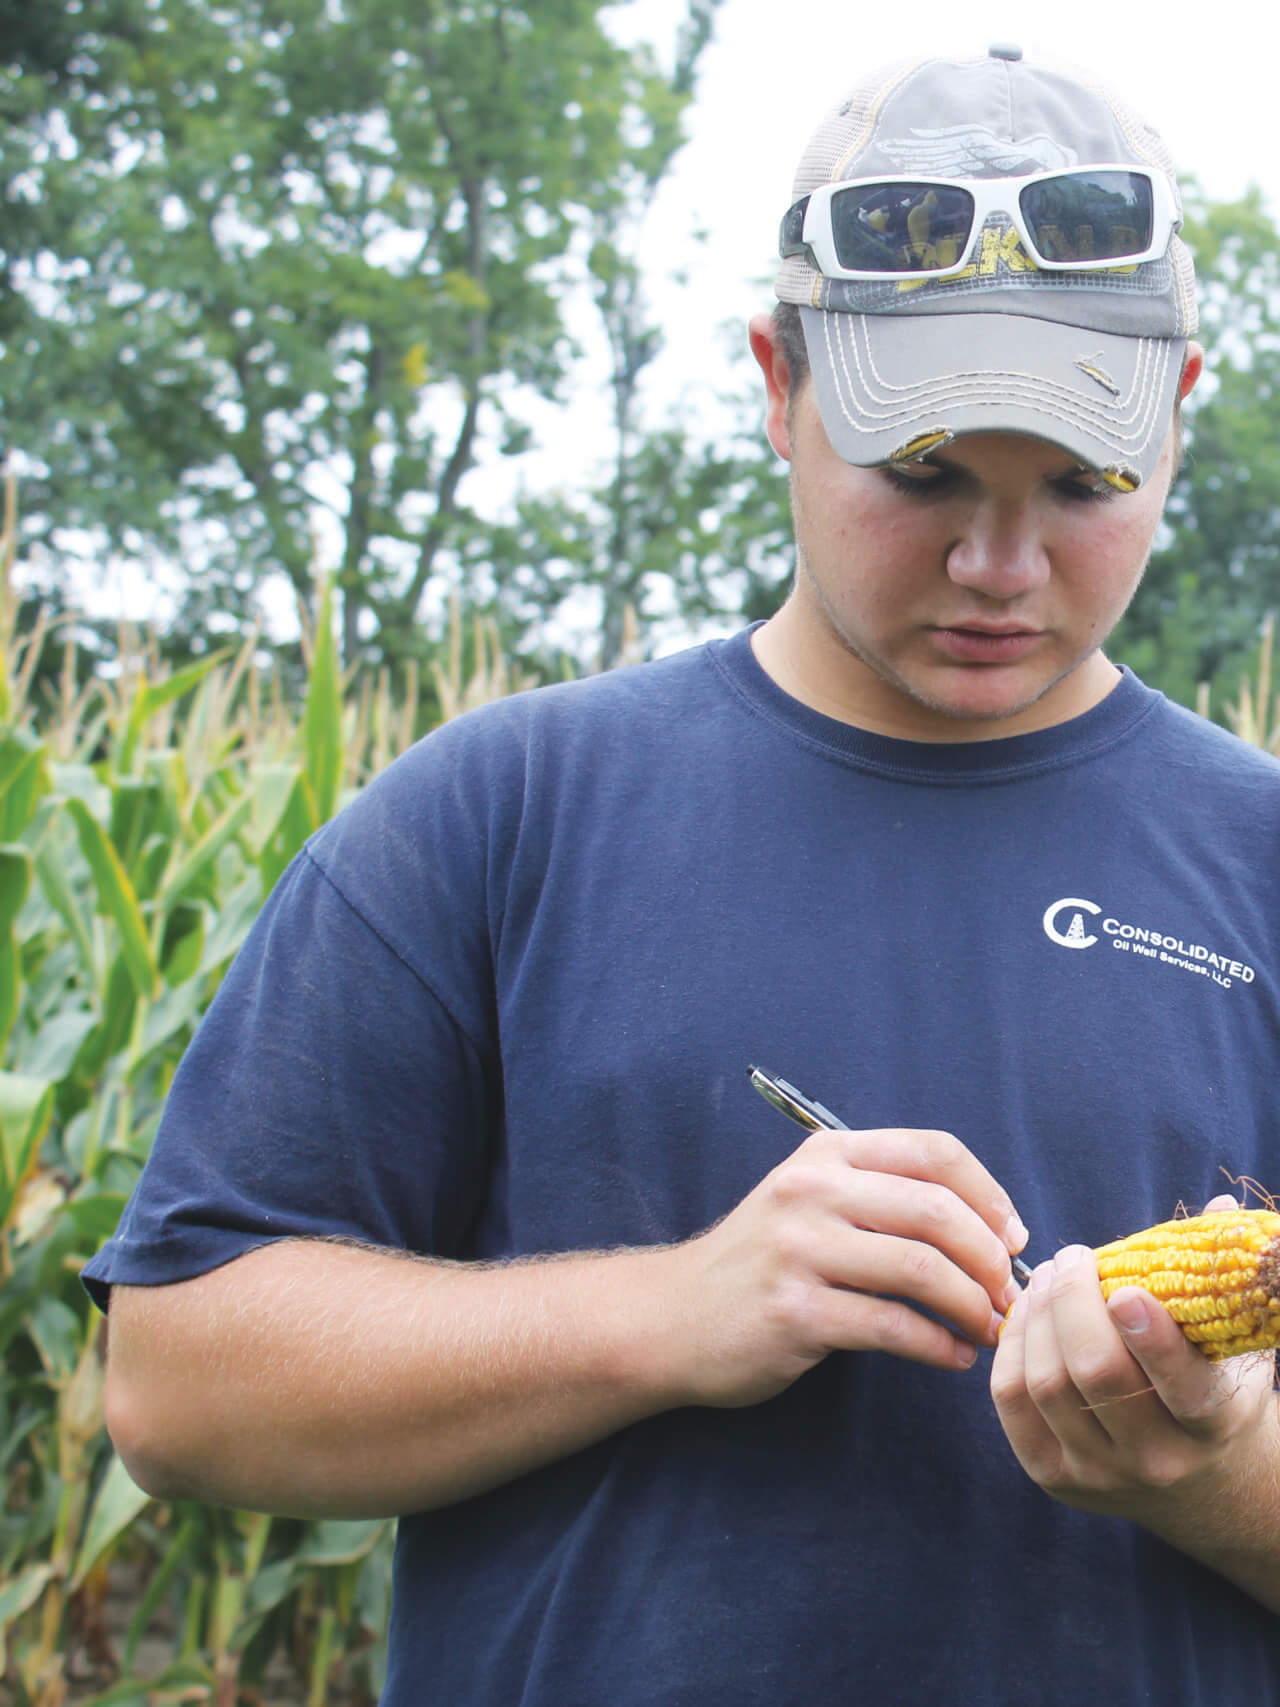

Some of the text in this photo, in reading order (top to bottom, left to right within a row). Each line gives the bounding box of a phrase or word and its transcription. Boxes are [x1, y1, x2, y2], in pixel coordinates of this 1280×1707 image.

[1102, 918, 1255, 984] CONSOLIDATED
[1112, 938, 1232, 988] Oil Well Services, LLC
